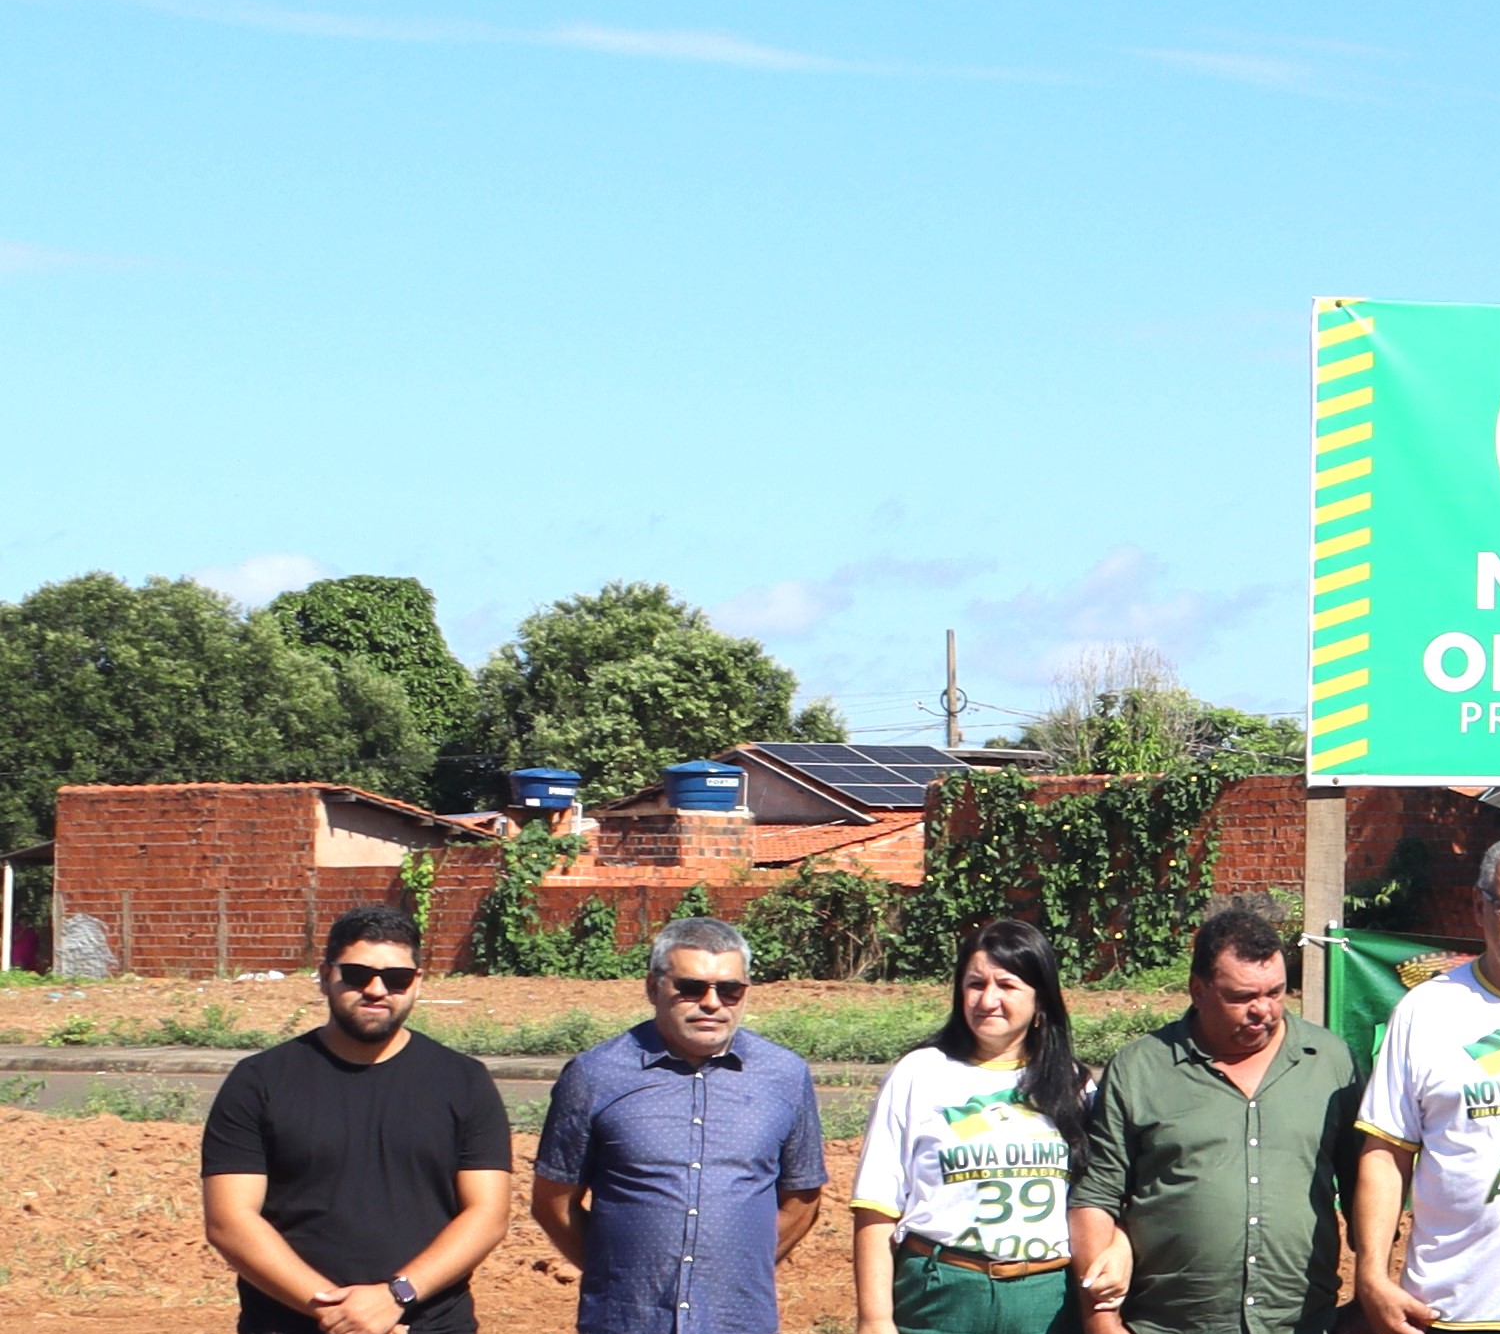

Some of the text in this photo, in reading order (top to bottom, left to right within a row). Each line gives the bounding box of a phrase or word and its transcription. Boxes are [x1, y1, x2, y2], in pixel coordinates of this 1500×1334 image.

[938, 1139, 1069, 1174] NOVA OLÍMP
[975, 1178, 1057, 1225] 39
[952, 1226, 1069, 1259] Anos
